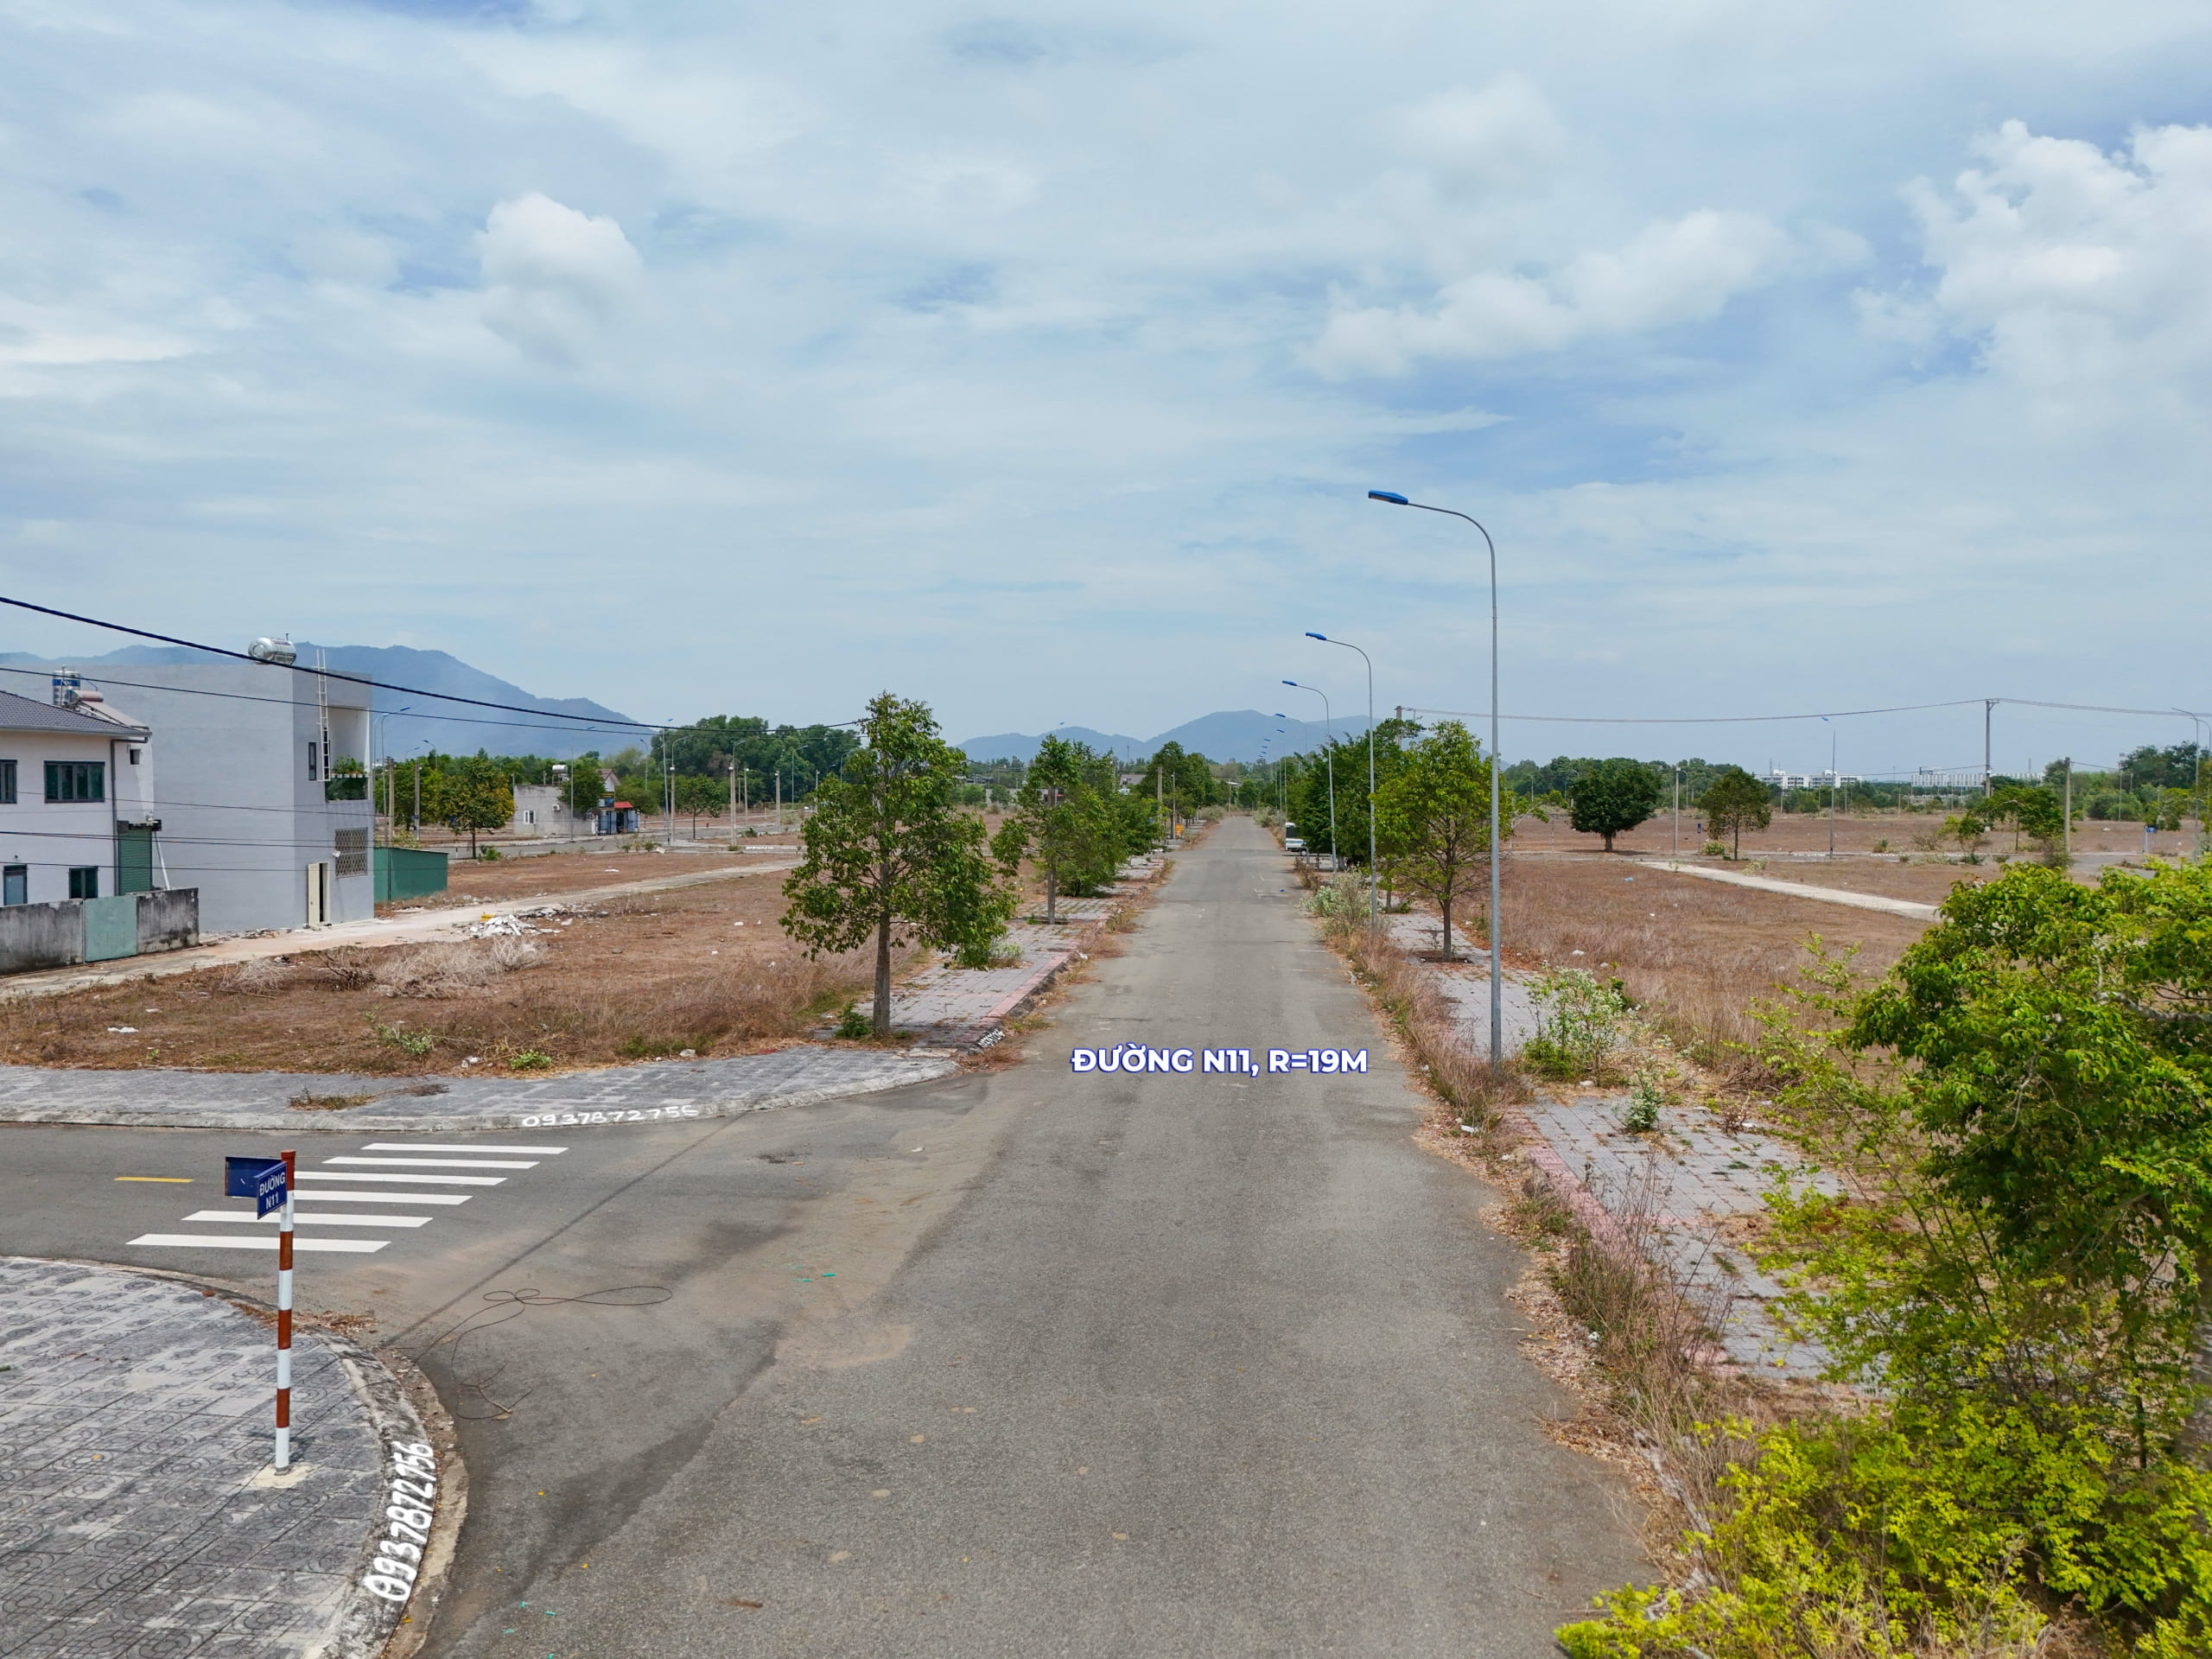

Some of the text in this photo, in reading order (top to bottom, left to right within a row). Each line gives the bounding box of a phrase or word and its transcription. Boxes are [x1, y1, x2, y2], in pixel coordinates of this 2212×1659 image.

[522, 1104, 699, 1128] 0937872756
[259, 1172, 286, 1197] ĐƯỜNG
[265, 1192, 279, 1210] N11
[364, 1440, 436, 1601] 0937872756
